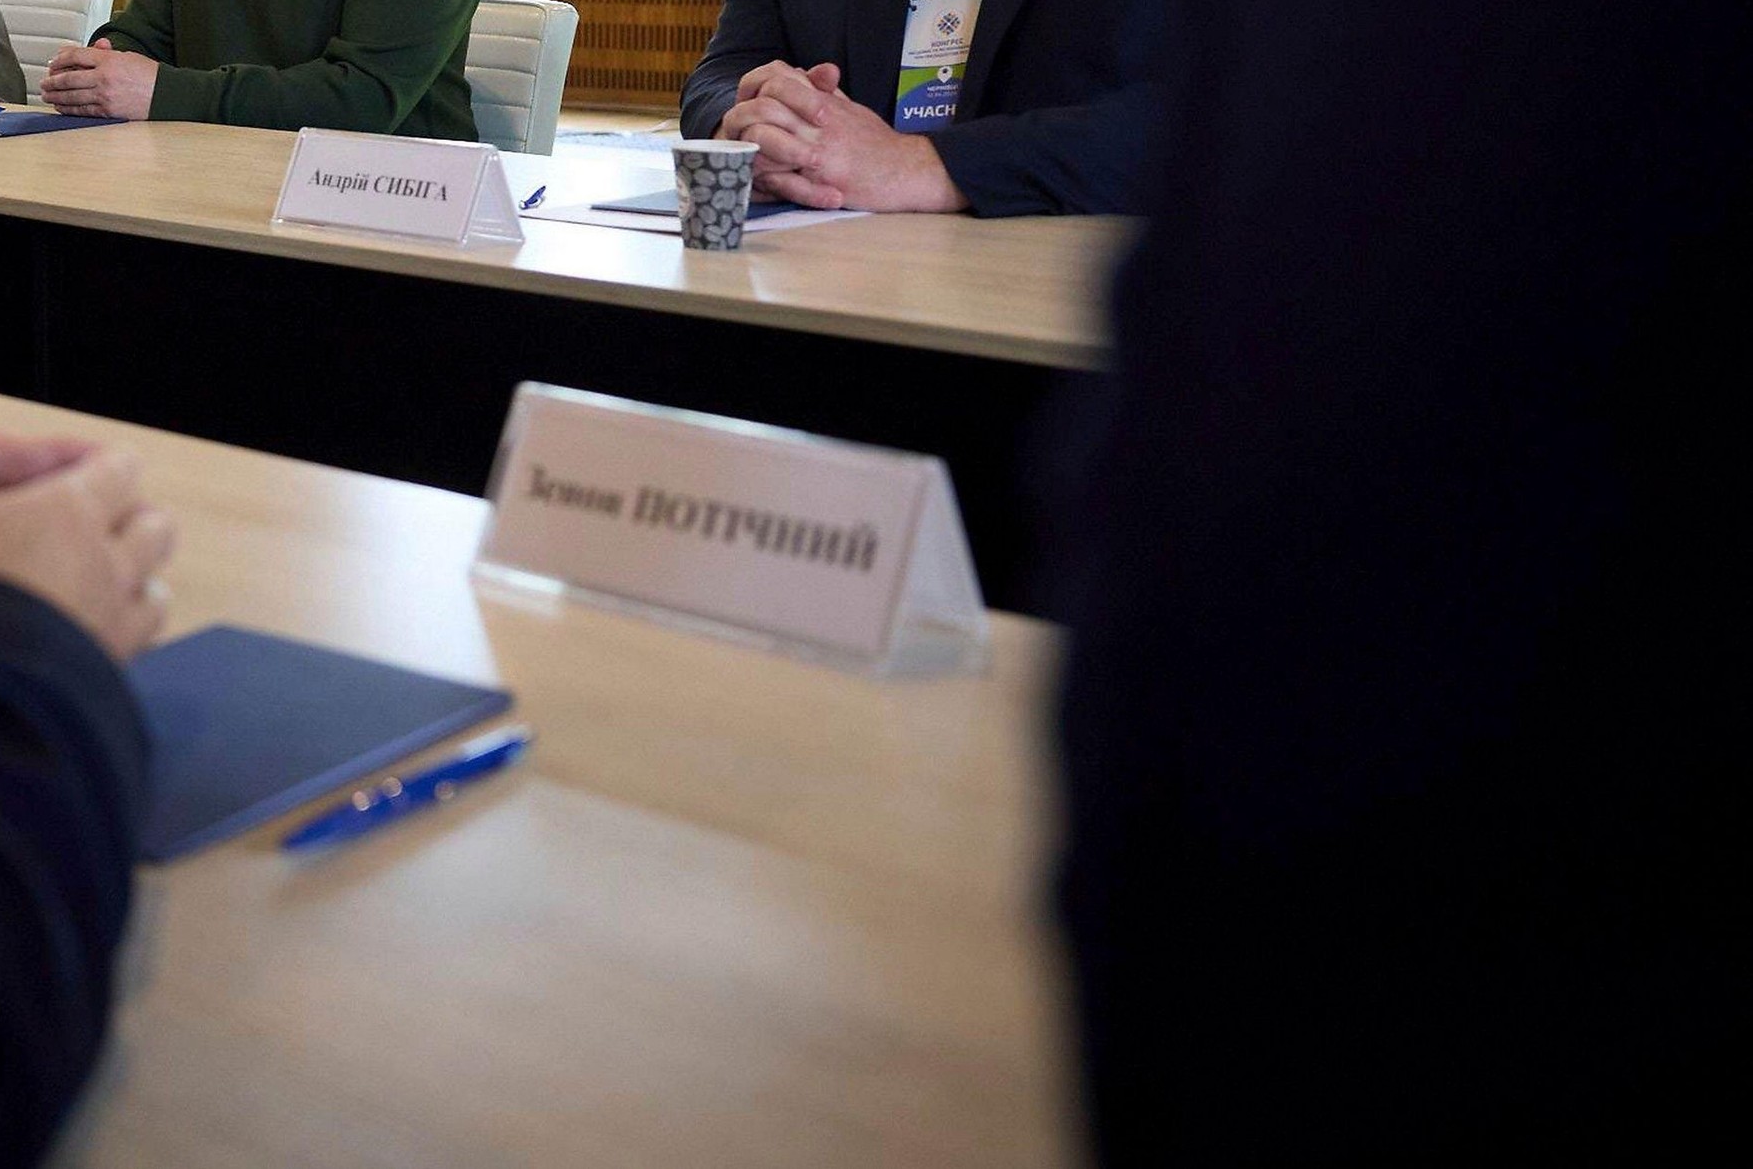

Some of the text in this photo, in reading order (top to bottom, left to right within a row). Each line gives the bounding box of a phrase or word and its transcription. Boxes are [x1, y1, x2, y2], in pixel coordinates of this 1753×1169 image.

[307, 167, 449, 202] Андрій СИБІГА
[632, 484, 880, 573] ПОТІЧНИЙ
